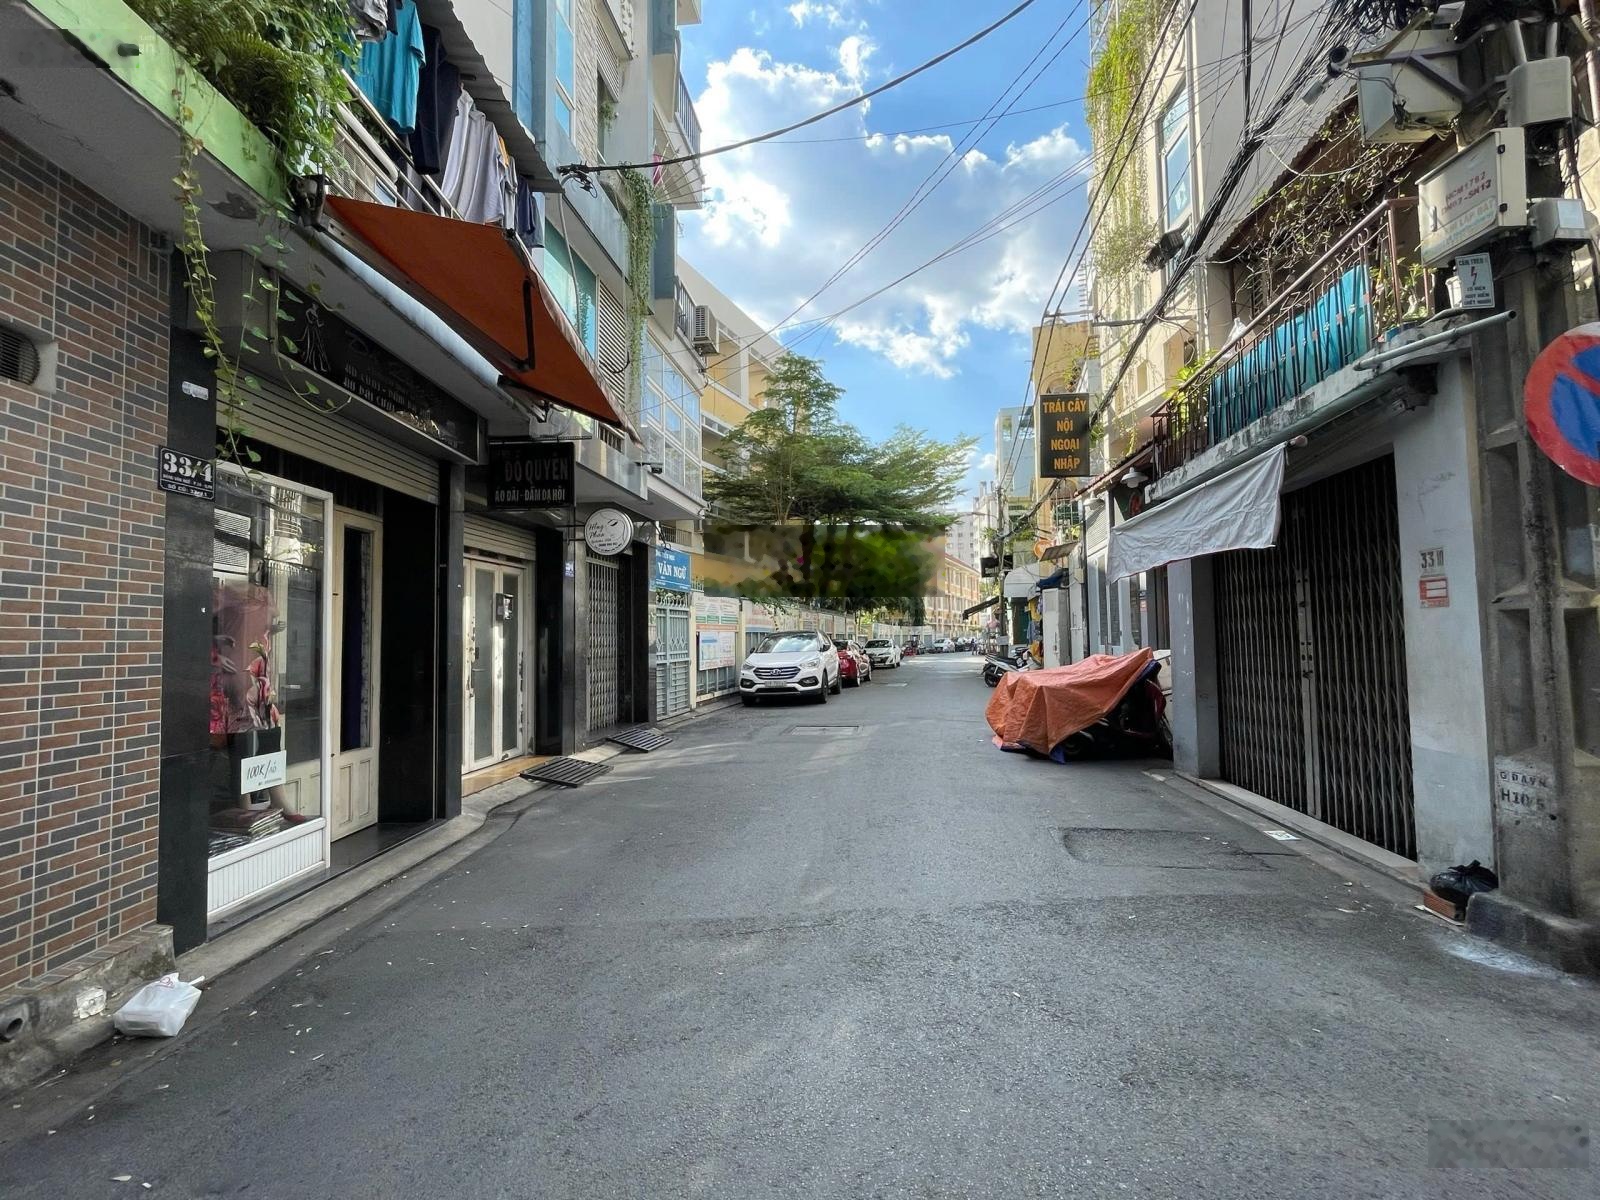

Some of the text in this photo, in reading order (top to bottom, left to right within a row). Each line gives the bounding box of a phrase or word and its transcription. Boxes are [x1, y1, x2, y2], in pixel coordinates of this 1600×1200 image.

[1043, 397, 1086, 413] TRÁI CÂY
[1056, 417, 1073, 434] NỘI
[1051, 438, 1080, 452] NGOẠI
[163, 452, 213, 483] 33/4
[1054, 455, 1080, 472] NHẬP
